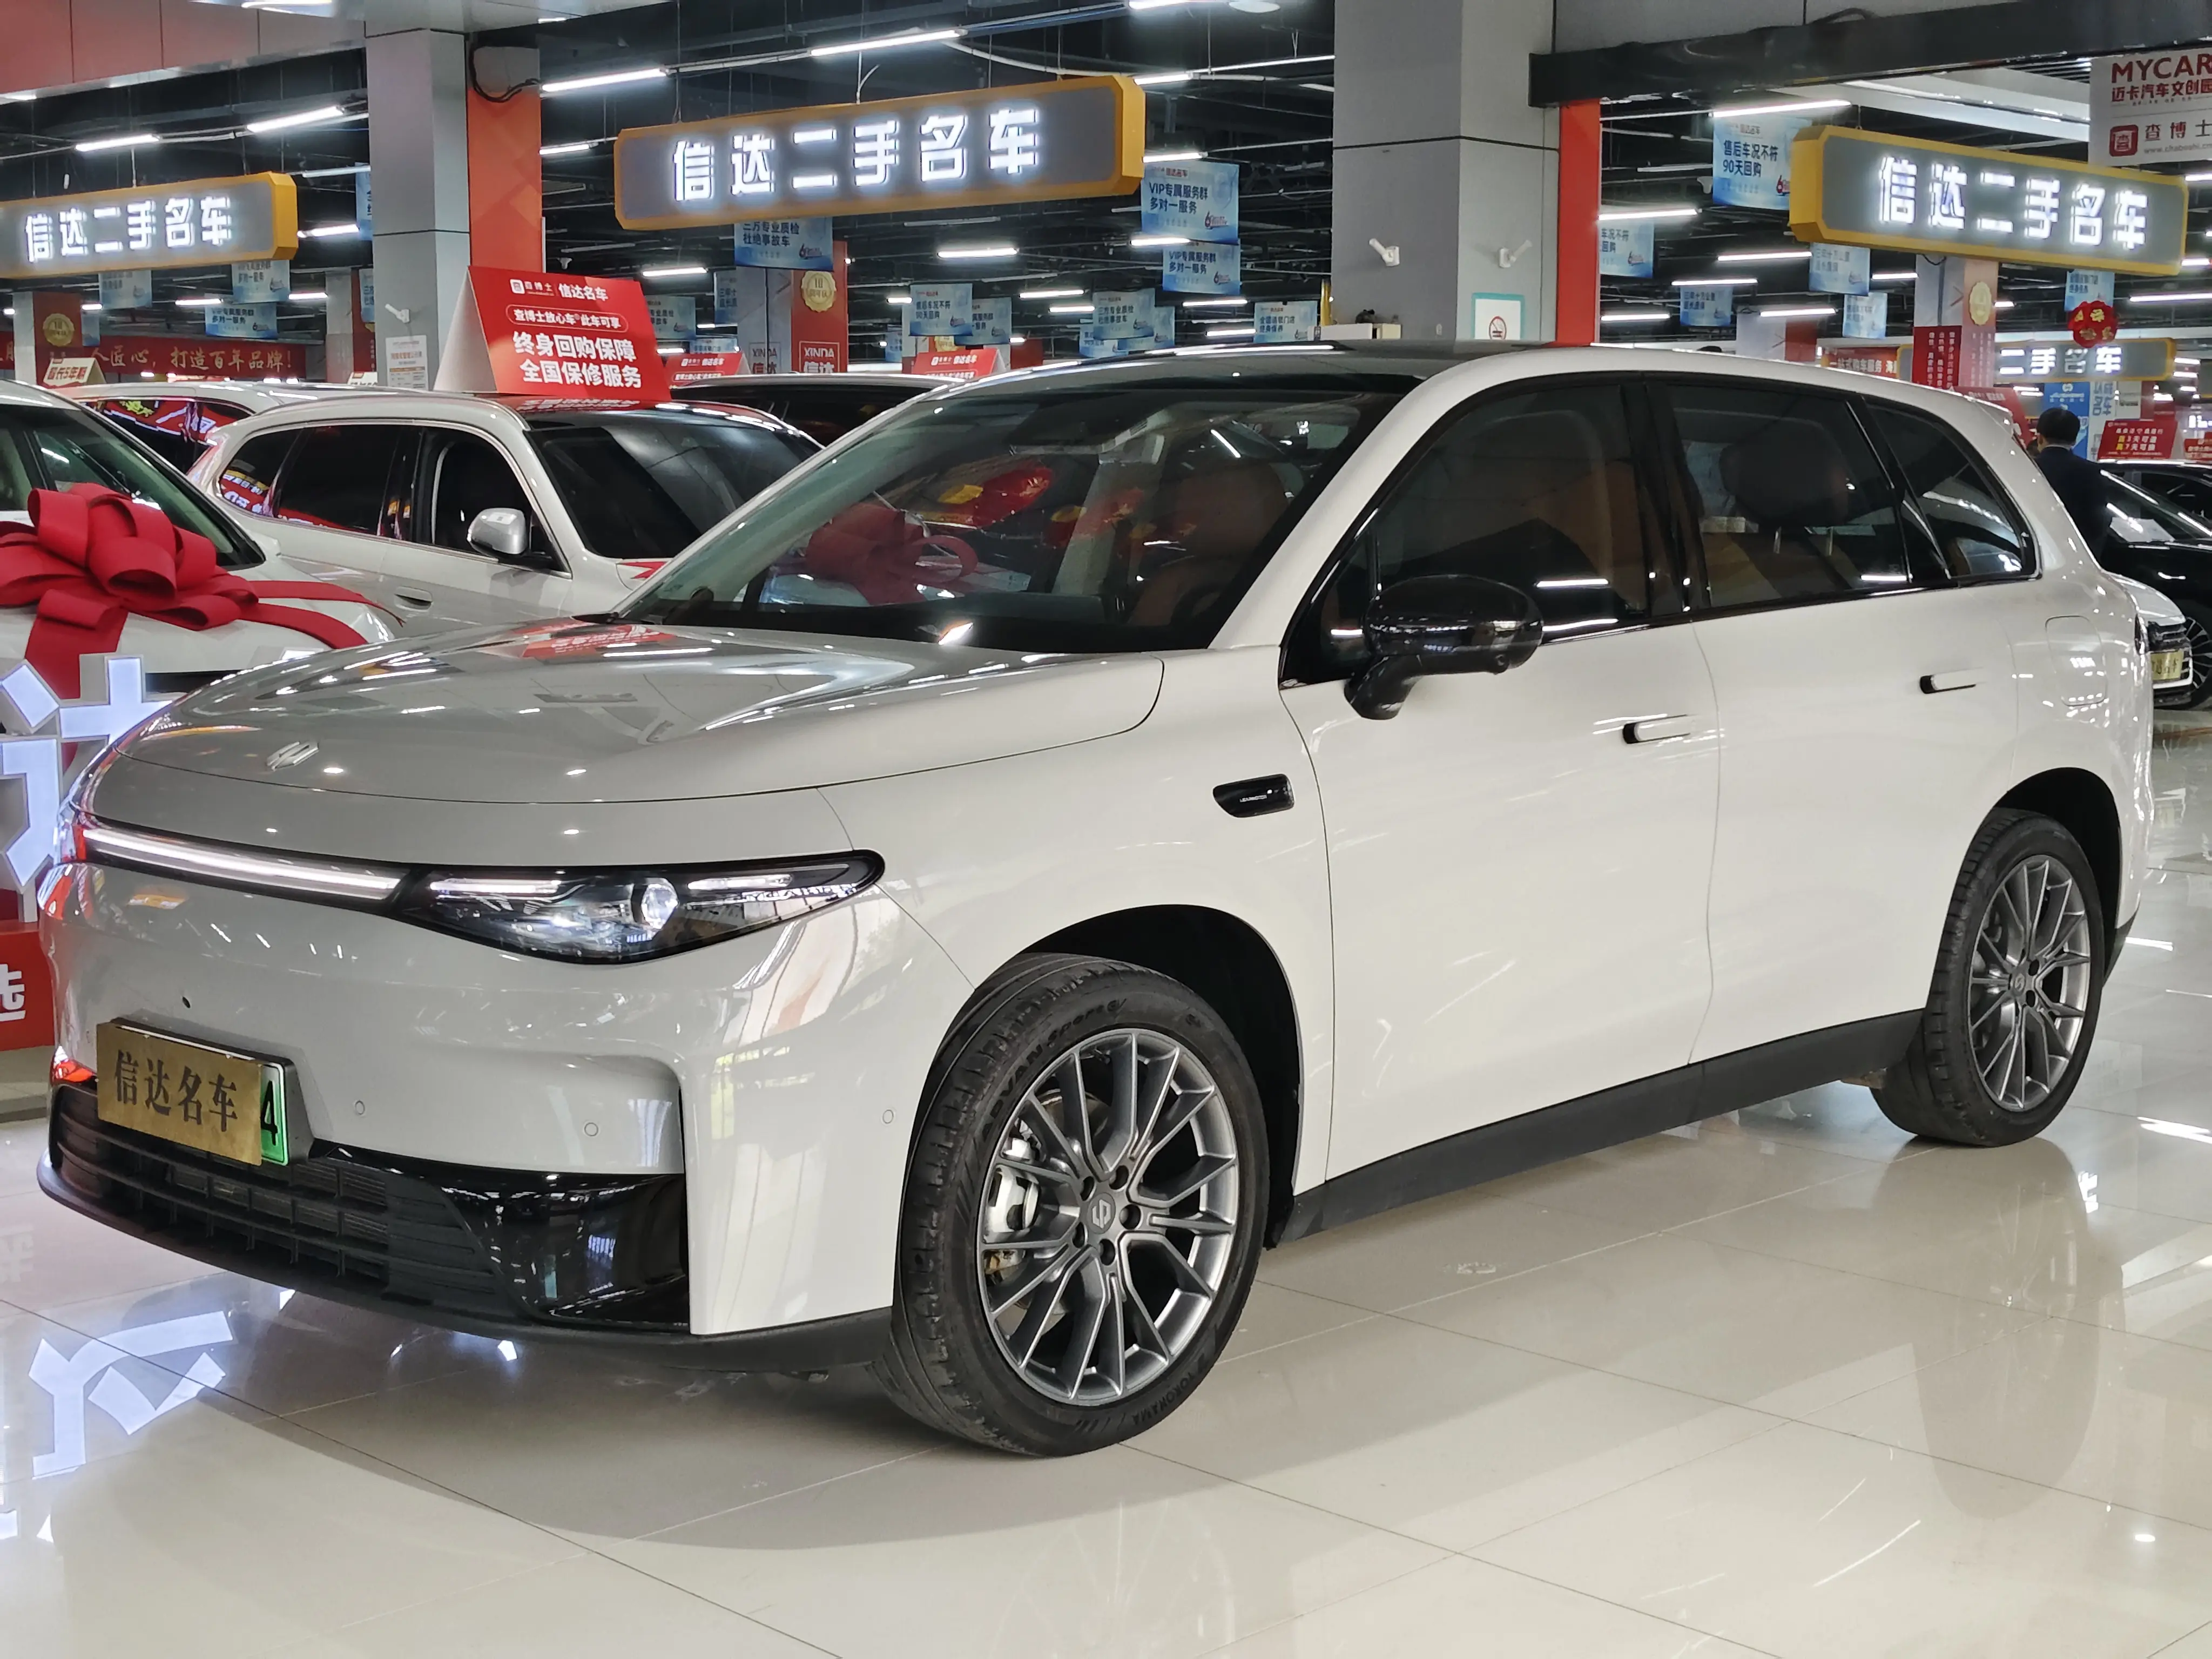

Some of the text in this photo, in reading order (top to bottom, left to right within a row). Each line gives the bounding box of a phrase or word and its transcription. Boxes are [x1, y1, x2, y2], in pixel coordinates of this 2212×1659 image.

[2112, 53, 2212, 84] MYCAR
[2112, 78, 2212, 102] 迈卡汽车文创园
[2145, 120, 2212, 141] 查博士
[672, 109, 1038, 201] 信达二手名车
[1724, 140, 1778, 161] 售后车况不符
[1723, 159, 1762, 178] 90天回购
[1149, 182, 1208, 200] VIP专属服务群
[1150, 197, 1197, 214] 多对一服务
[1879, 157, 2148, 250] 信达二手名车
[25, 196, 231, 263] 信达二手名车
[558, 282, 609, 301] 信达名车
[512, 331, 637, 362] 终身回购保障
[804, 347, 834, 358] XINDA
[1999, 346, 2123, 375] 二手名车
[520, 359, 642, 388] 全国保修服务
[114, 1050, 238, 1132] 信达名车
[261, 1080, 279, 1146] 4
